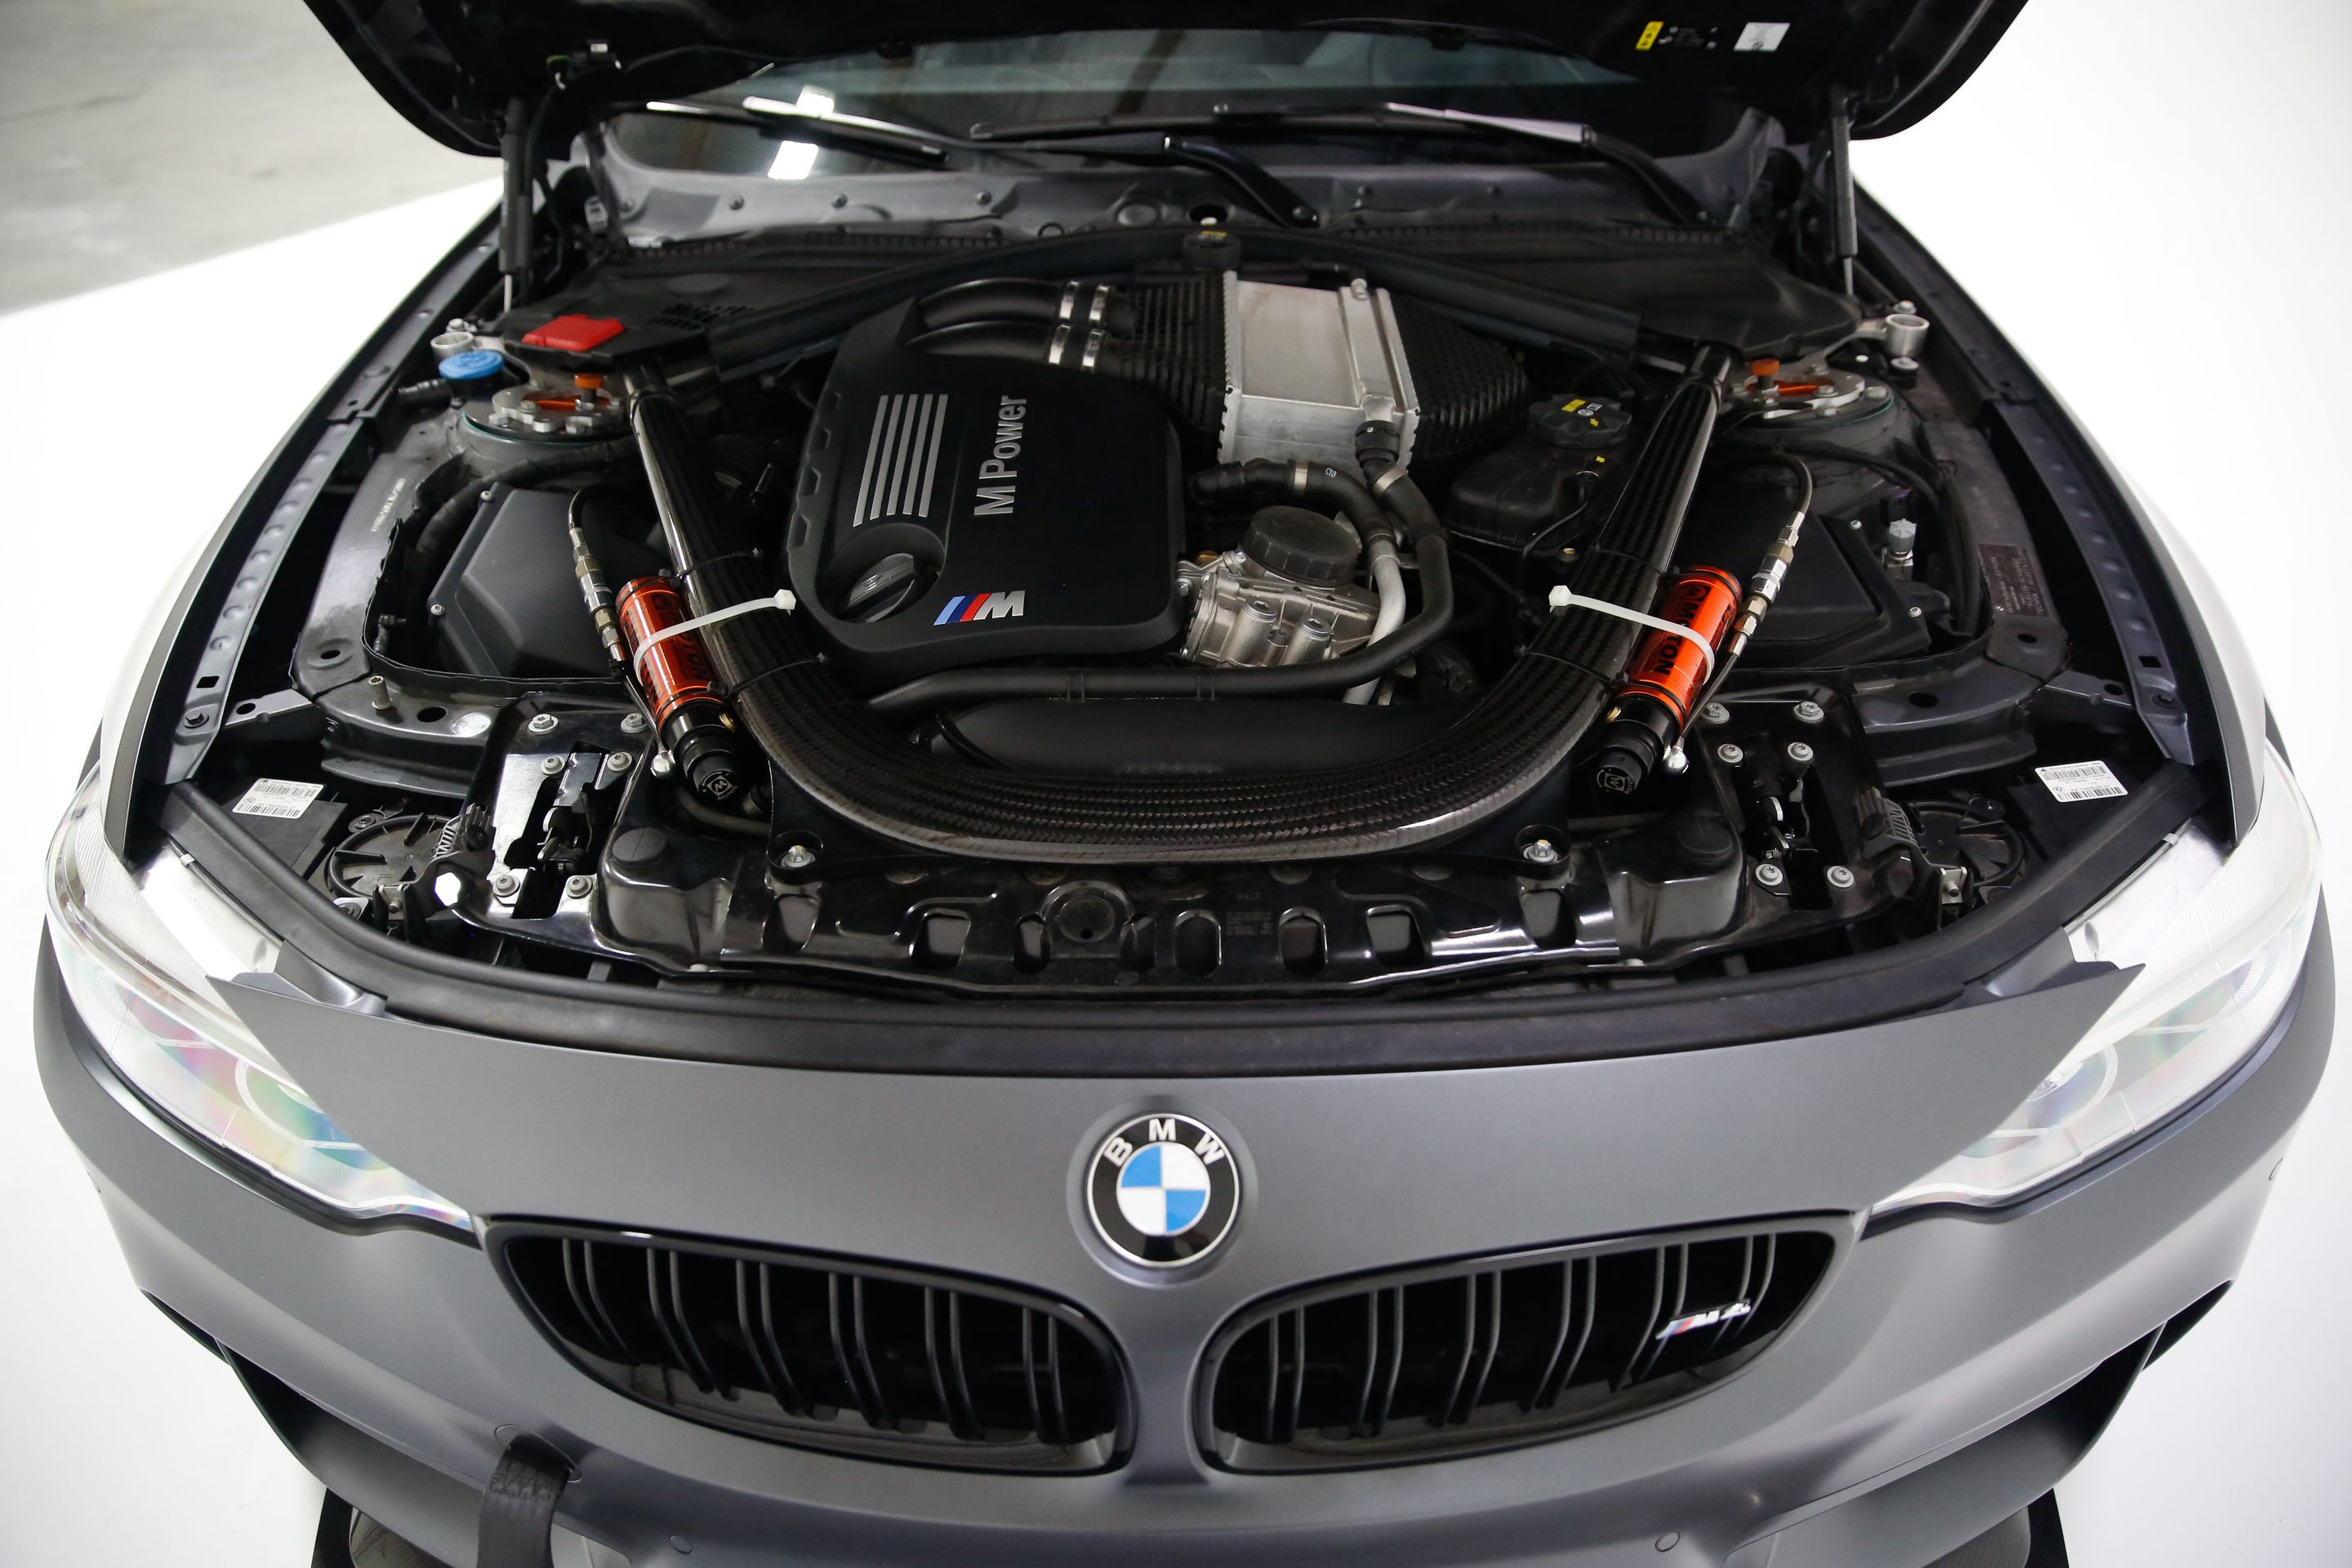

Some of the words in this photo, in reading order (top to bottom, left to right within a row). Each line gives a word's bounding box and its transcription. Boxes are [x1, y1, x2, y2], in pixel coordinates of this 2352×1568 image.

[978, 395, 1027, 479] Power
[974, 486, 1016, 515] M
[973, 590, 1026, 620] M
[1655, 601, 1702, 675] MTON
[1103, 1118, 1225, 1167] BMW
